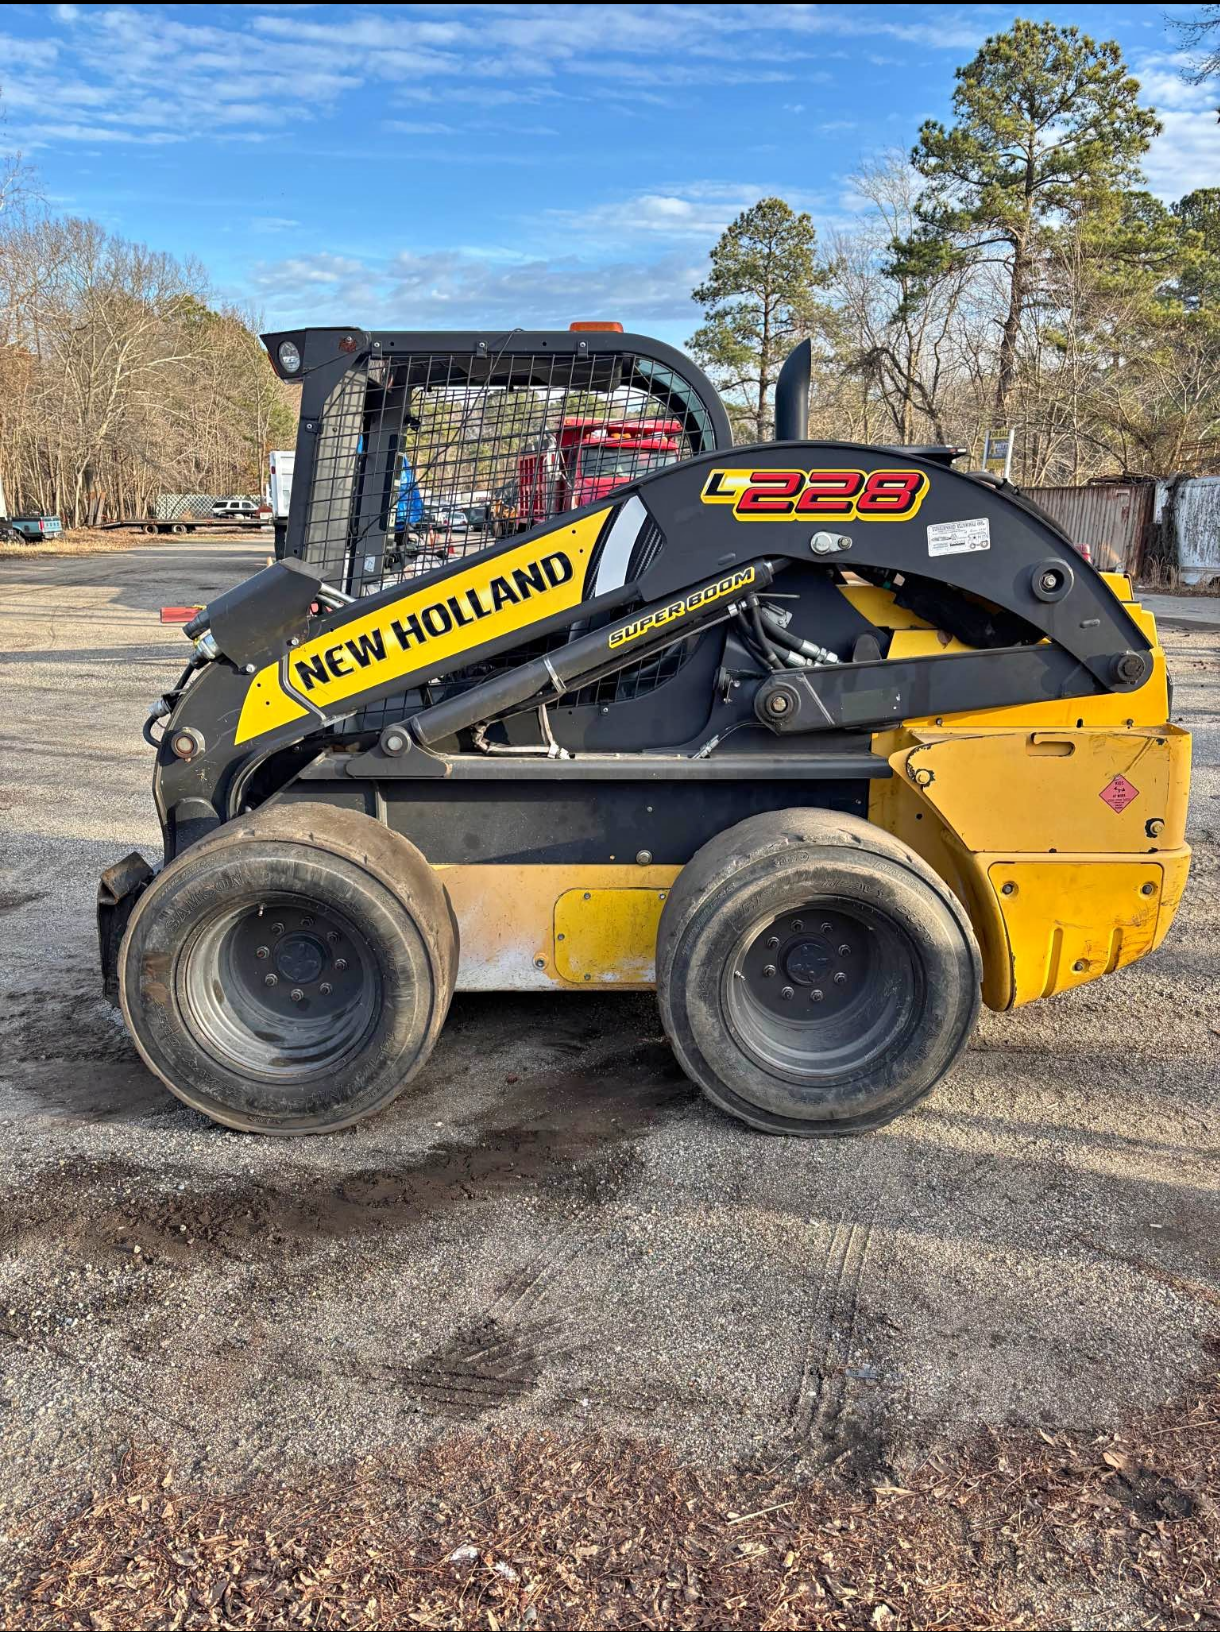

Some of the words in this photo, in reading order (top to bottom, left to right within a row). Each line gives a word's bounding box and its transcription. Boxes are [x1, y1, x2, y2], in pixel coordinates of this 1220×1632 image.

[701, 469, 930, 521] L228
[294, 628, 388, 691] NEW
[390, 551, 575, 652] HOLLAND
[608, 600, 686, 649] SUPER
[686, 566, 755, 612] BOOM
